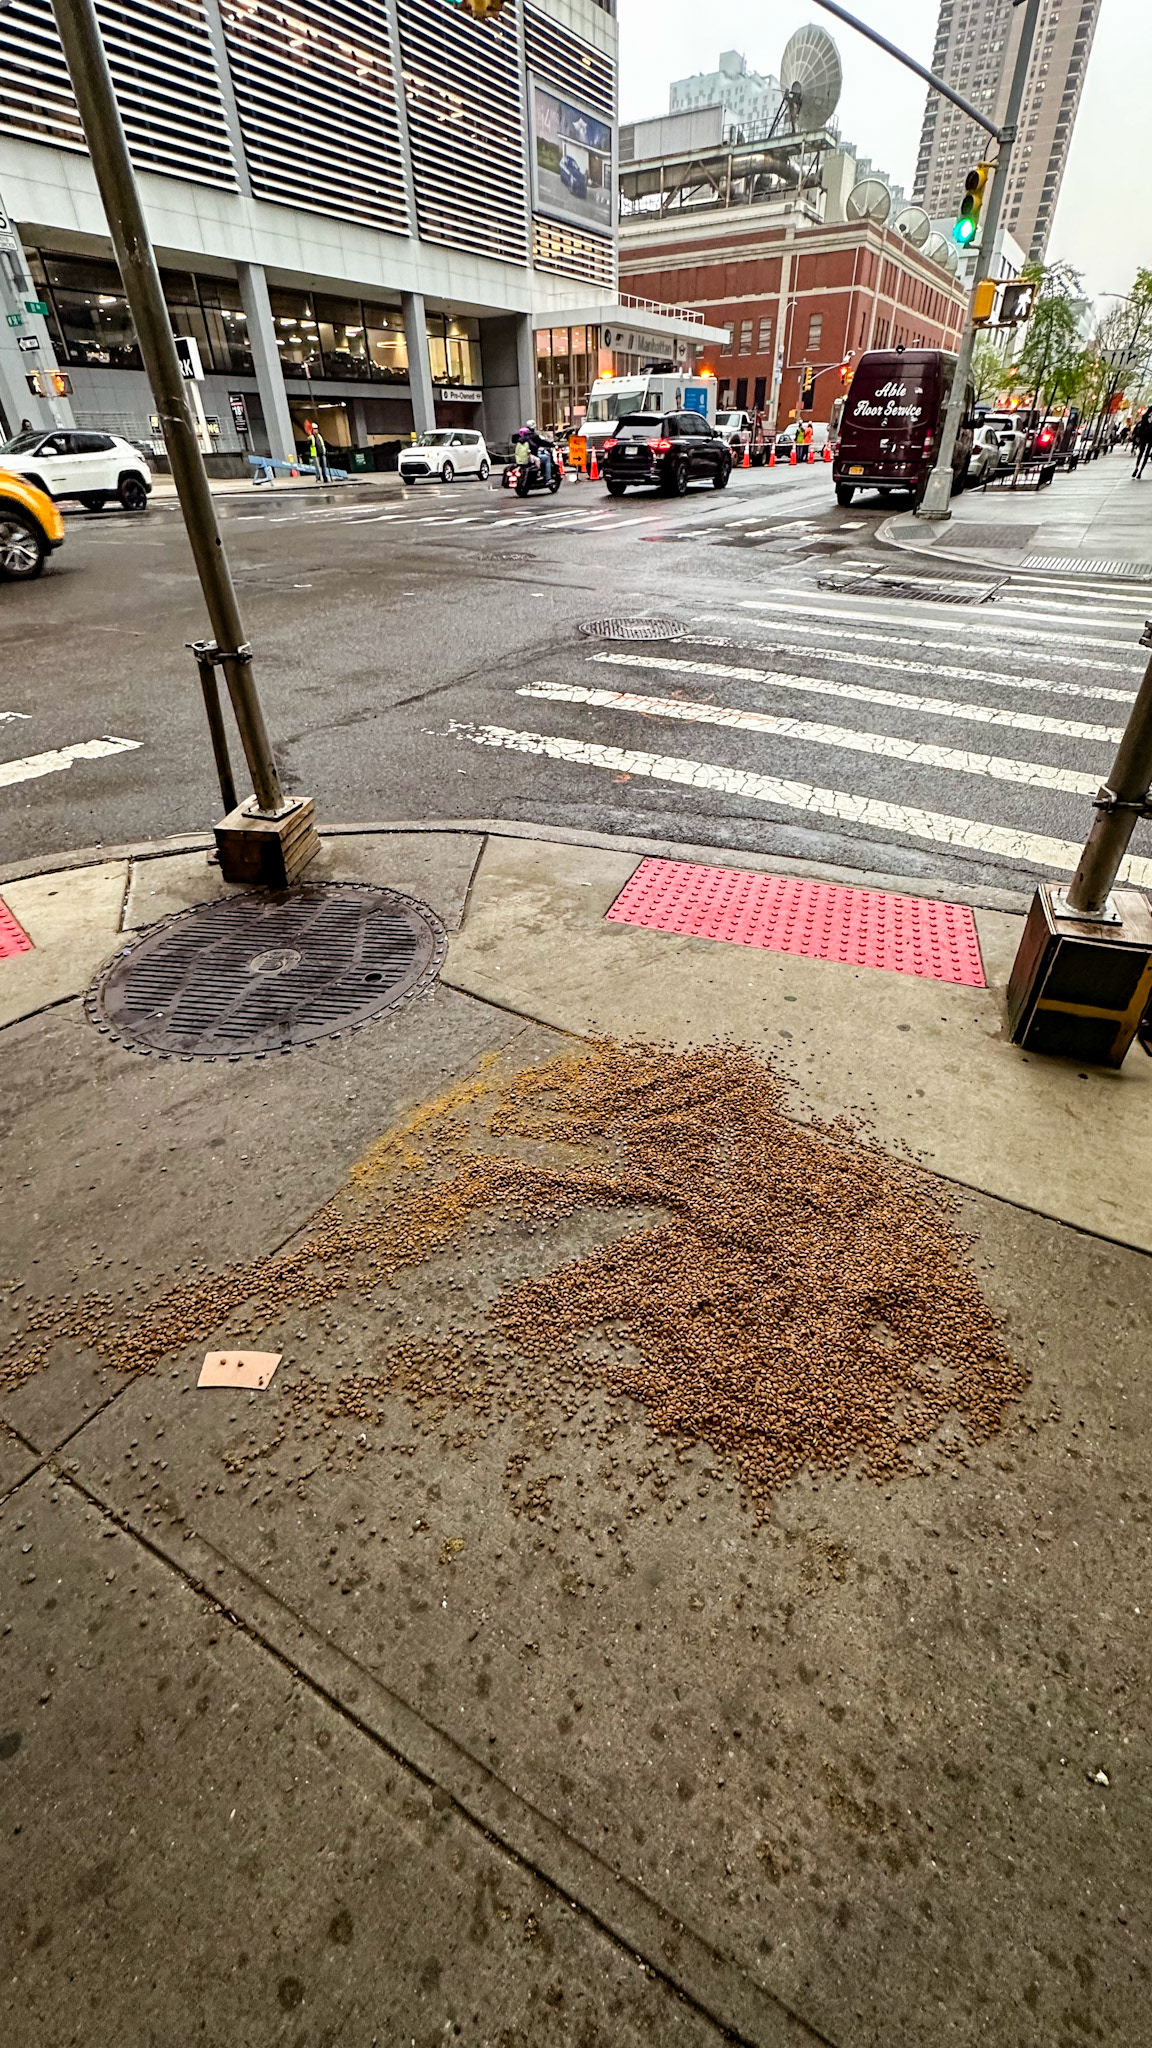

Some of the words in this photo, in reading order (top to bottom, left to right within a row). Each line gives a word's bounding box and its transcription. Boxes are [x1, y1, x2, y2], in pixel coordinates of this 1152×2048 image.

[638, 334, 672, 356] Manhattan
[450, 391, 475, 400] Pre-Owned
[875, 382, 907, 397] Able
[853, 400, 883, 417] Floor
[883, 400, 922, 416] Service
